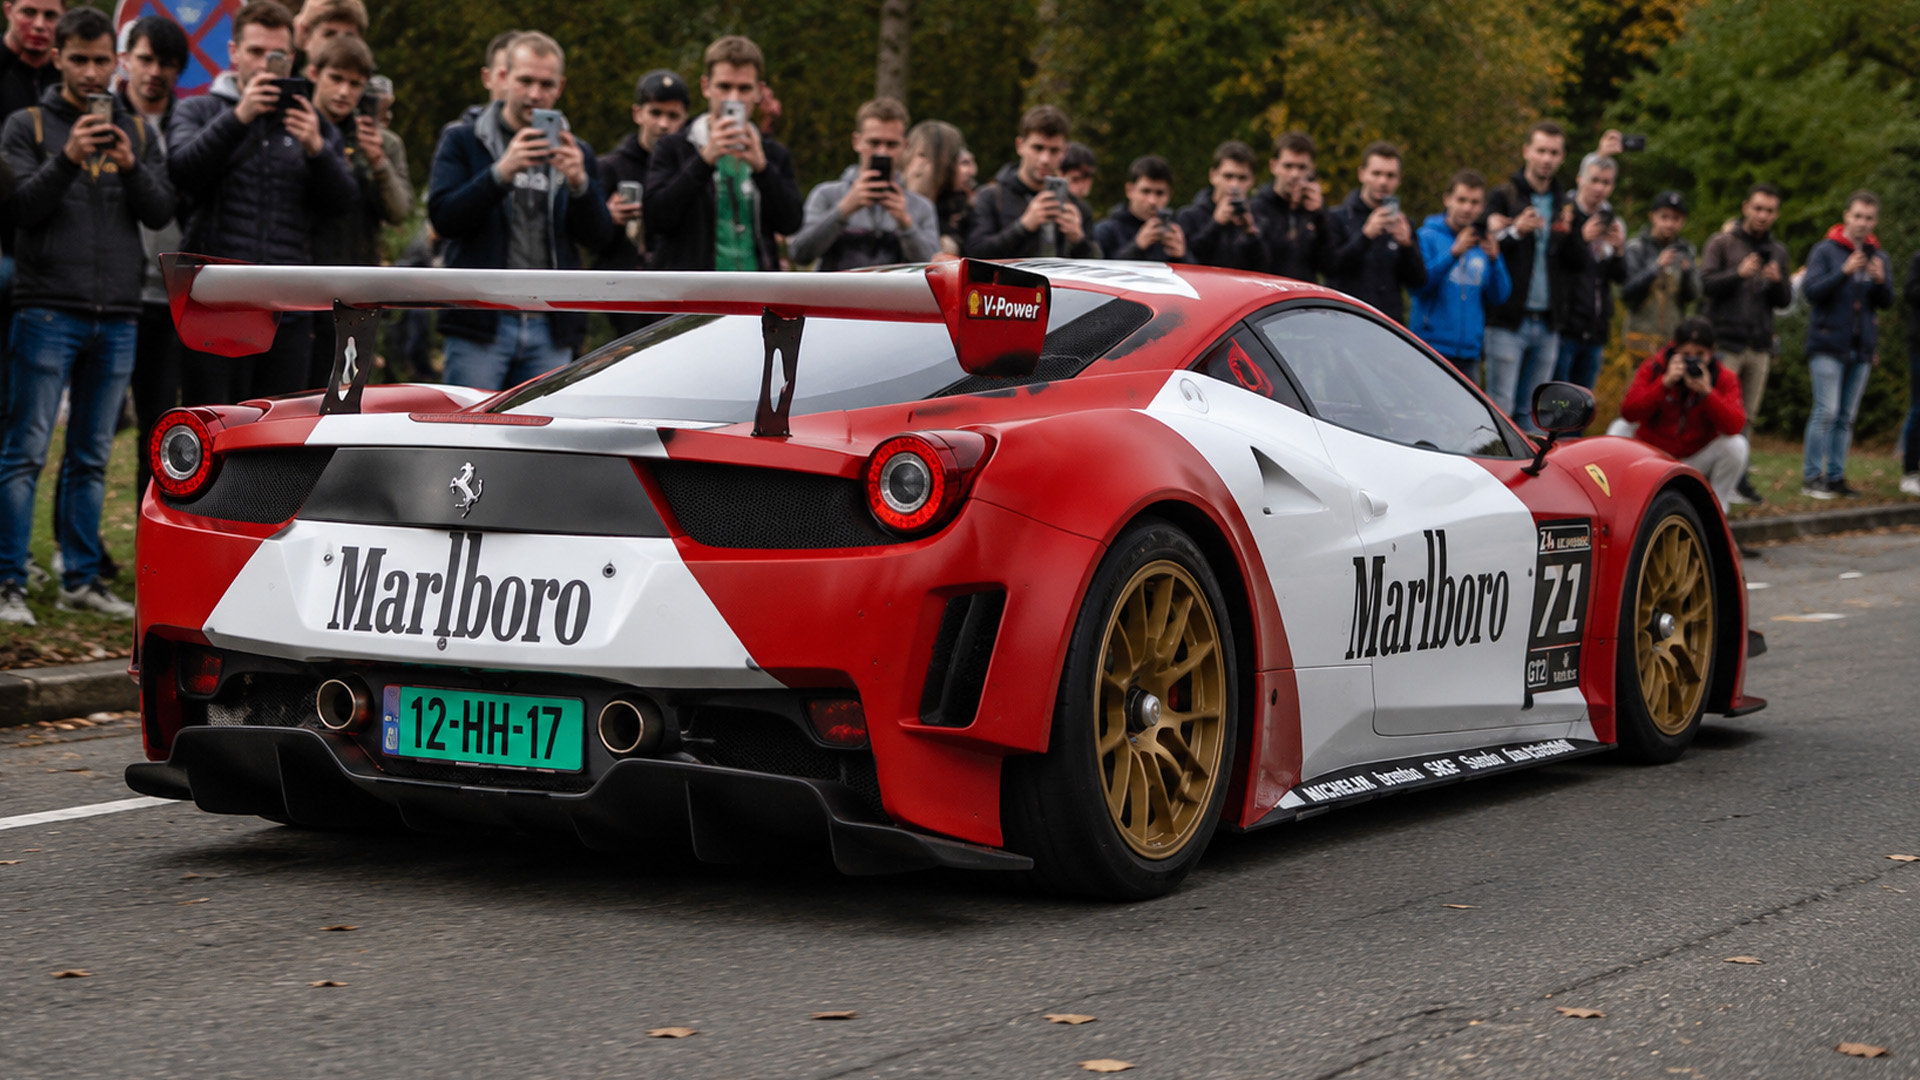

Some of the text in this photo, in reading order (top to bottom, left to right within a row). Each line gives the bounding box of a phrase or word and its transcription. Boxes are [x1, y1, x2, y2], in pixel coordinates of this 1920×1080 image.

[327, 531, 592, 646] Marlboro
[1345, 529, 1510, 660] Marlboro
[1536, 562, 1582, 638] 71
[1527, 658, 1547, 683] GT2
[411, 695, 563, 760] 12-HH-17
